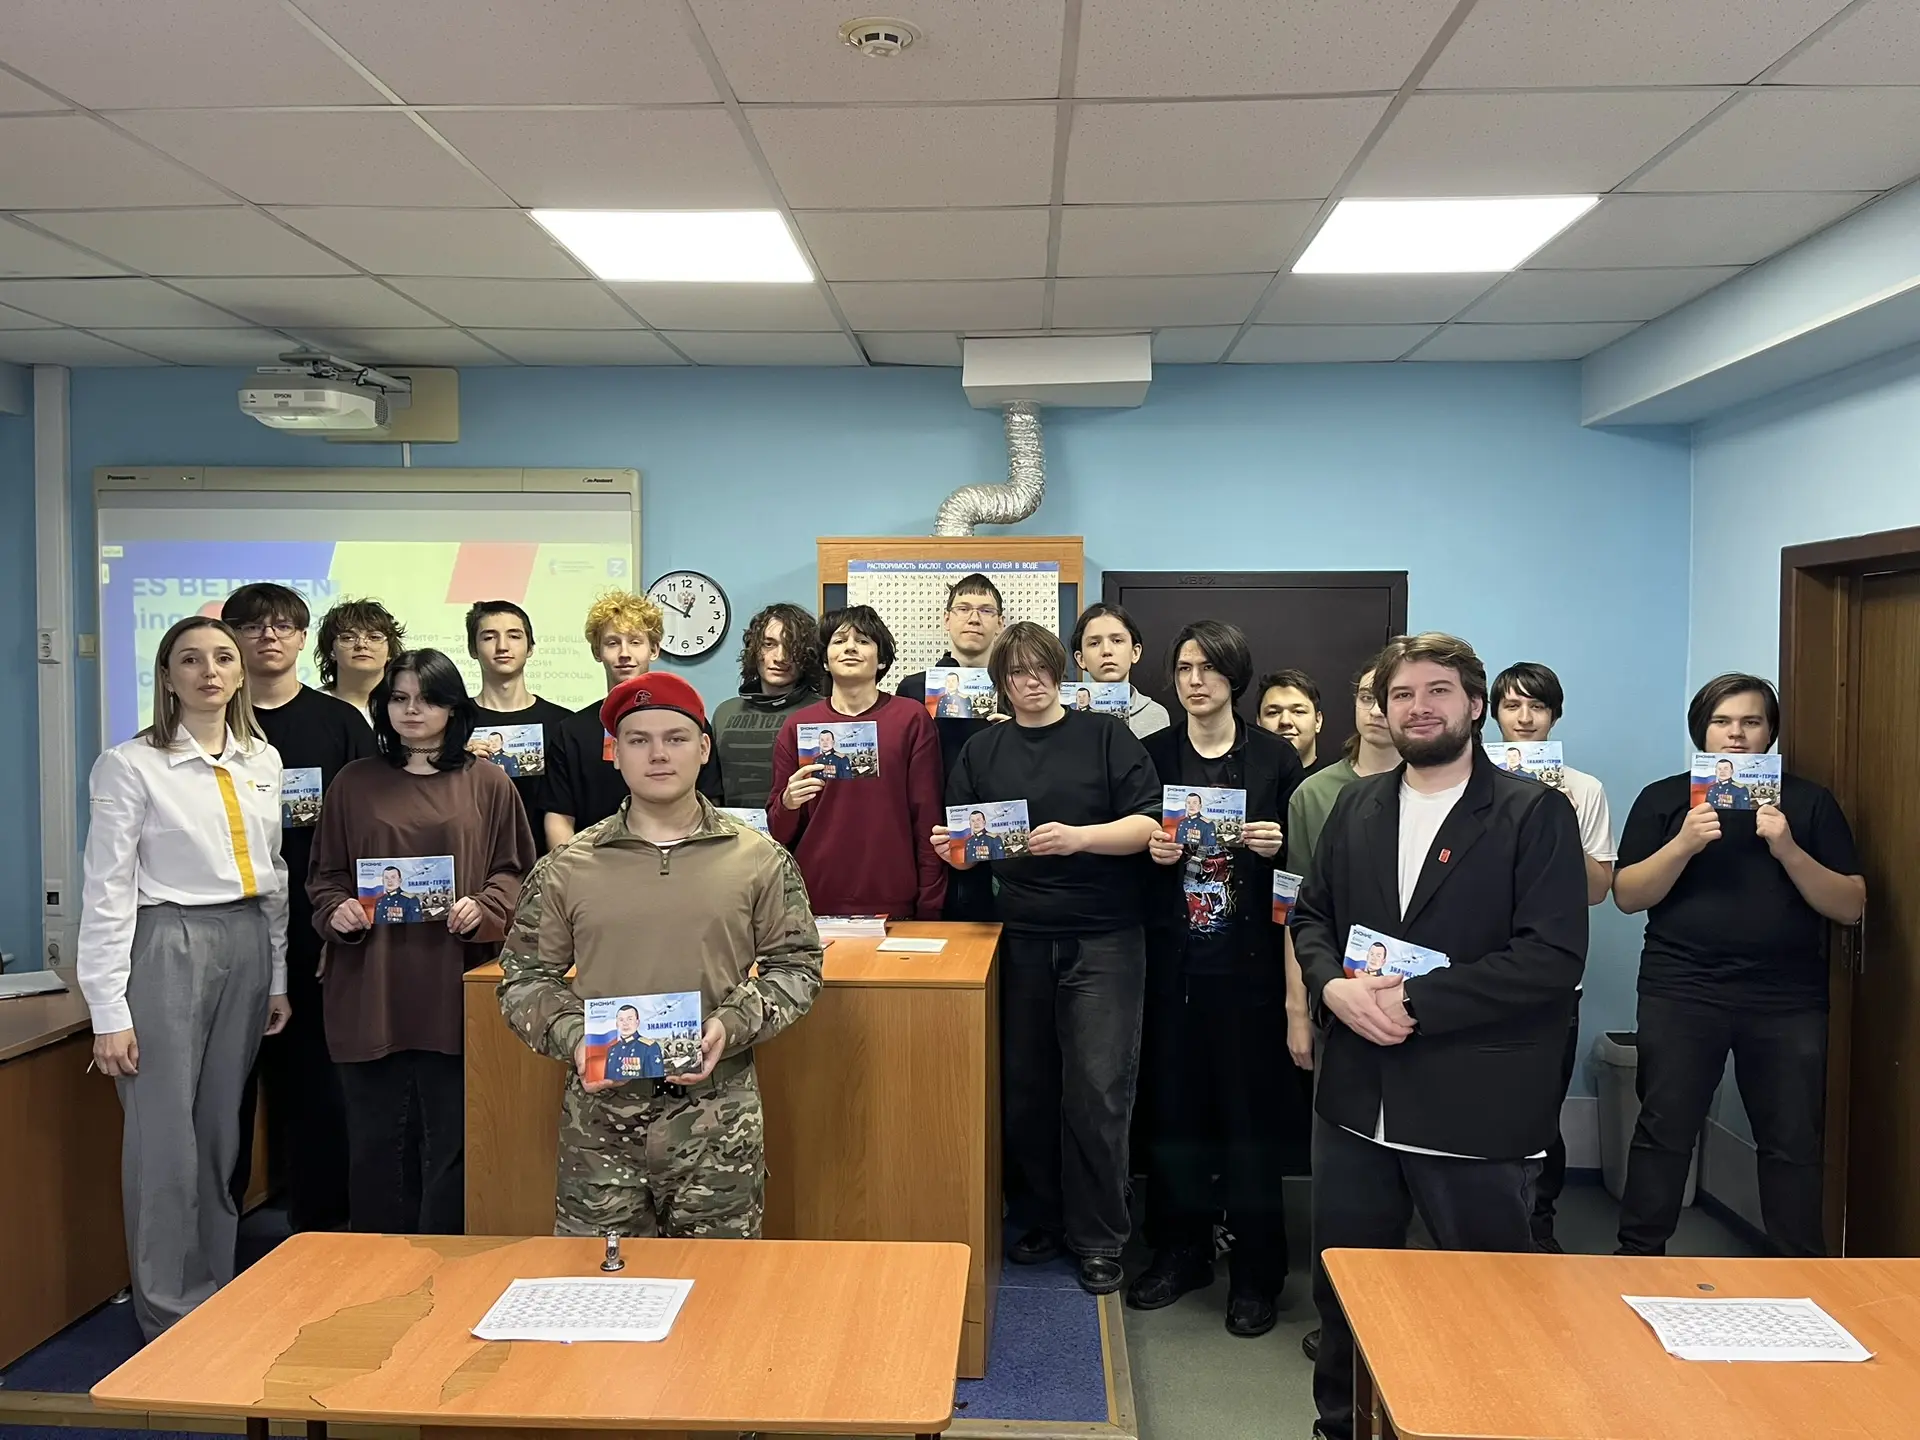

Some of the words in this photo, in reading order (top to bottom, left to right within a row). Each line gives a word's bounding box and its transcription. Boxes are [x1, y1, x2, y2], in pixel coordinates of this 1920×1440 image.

[866, 562, 916, 570] РАСТВОРИМОСТЬ
[945, 561, 982, 569] ОСНОВАНИЙ
[668, 583, 676, 592] 11
[681, 579, 692, 588] 12
[700, 584, 704, 592] 1
[656, 594, 667, 602] 10
[709, 596, 716, 604] 2
[713, 611, 720, 620] 3
[708, 626, 715, 634] 4
[668, 635, 674, 644] 7
[696, 636, 704, 644] 5
[681, 640, 689, 649] 6
